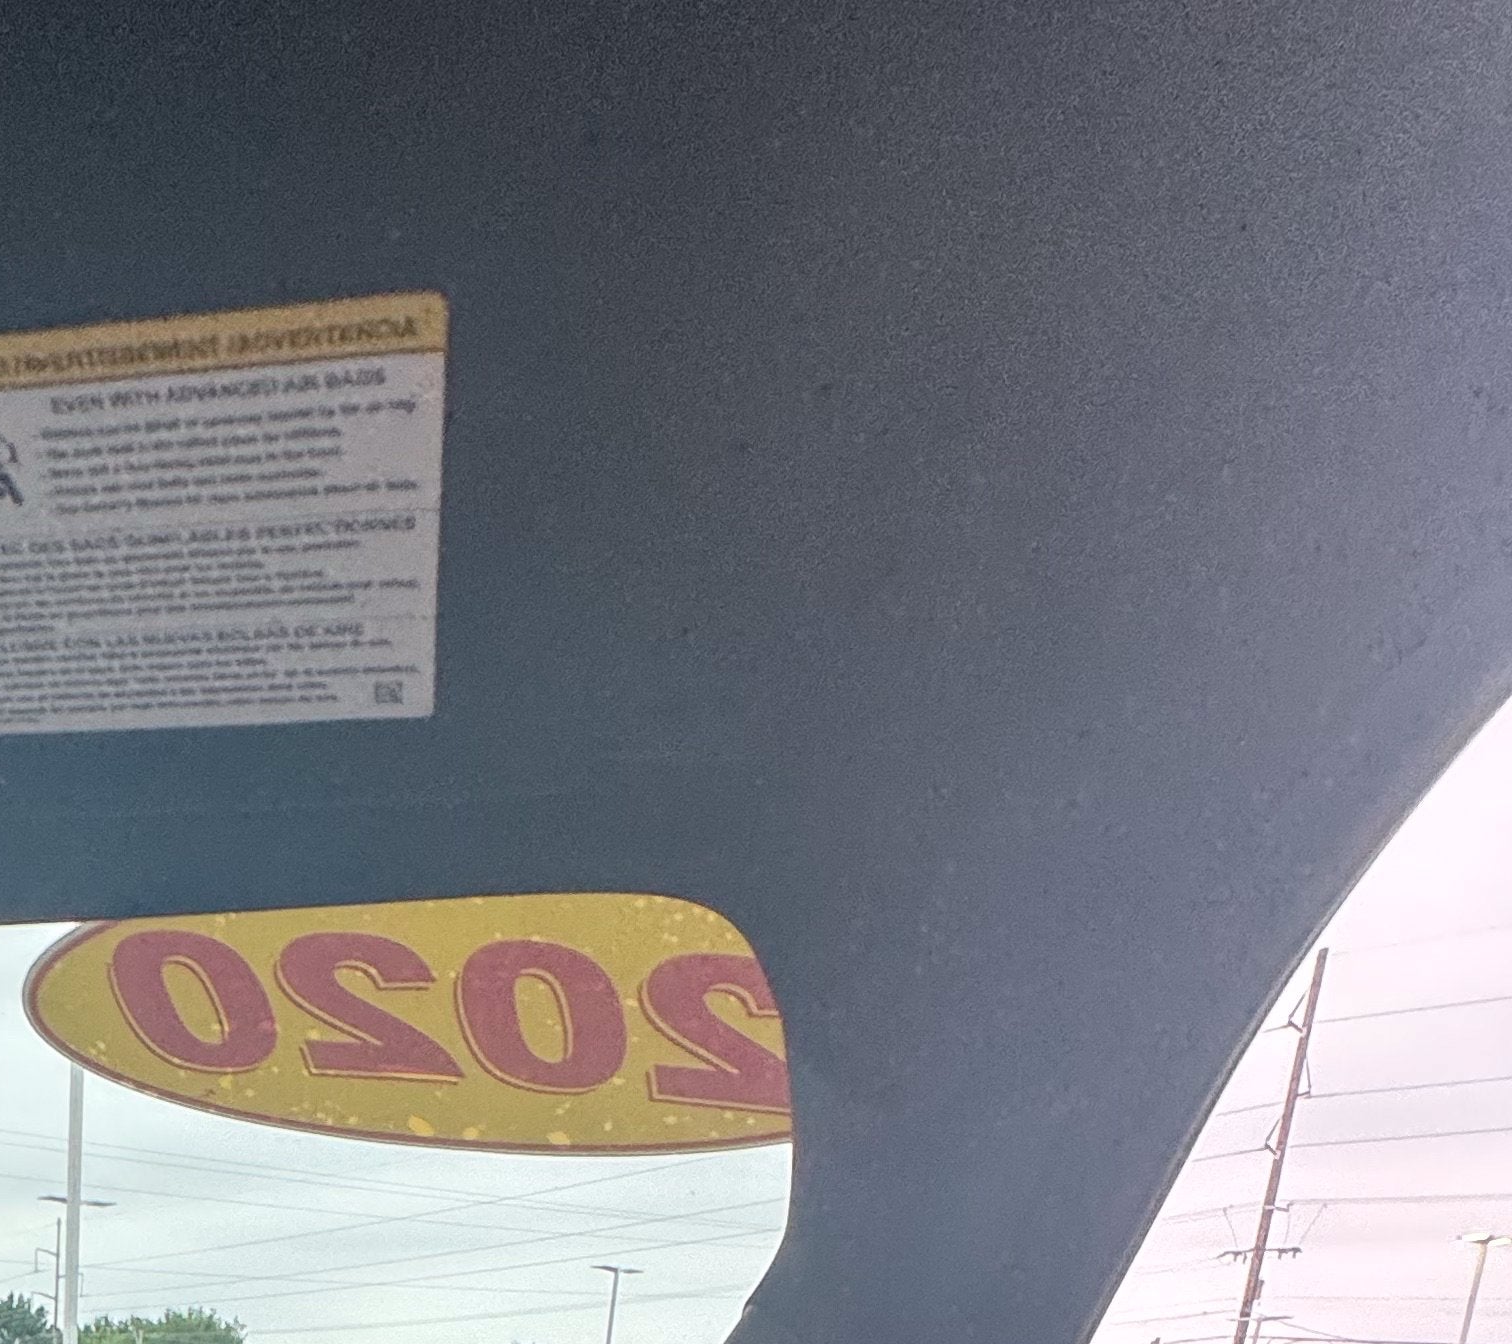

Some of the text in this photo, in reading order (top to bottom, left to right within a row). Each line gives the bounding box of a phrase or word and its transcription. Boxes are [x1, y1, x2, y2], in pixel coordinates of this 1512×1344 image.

[50, 395, 104, 415] EVEN
[109, 389, 160, 409] WITH
[167, 378, 279, 403] ADVANCED
[324, 367, 386, 389] BAGS
